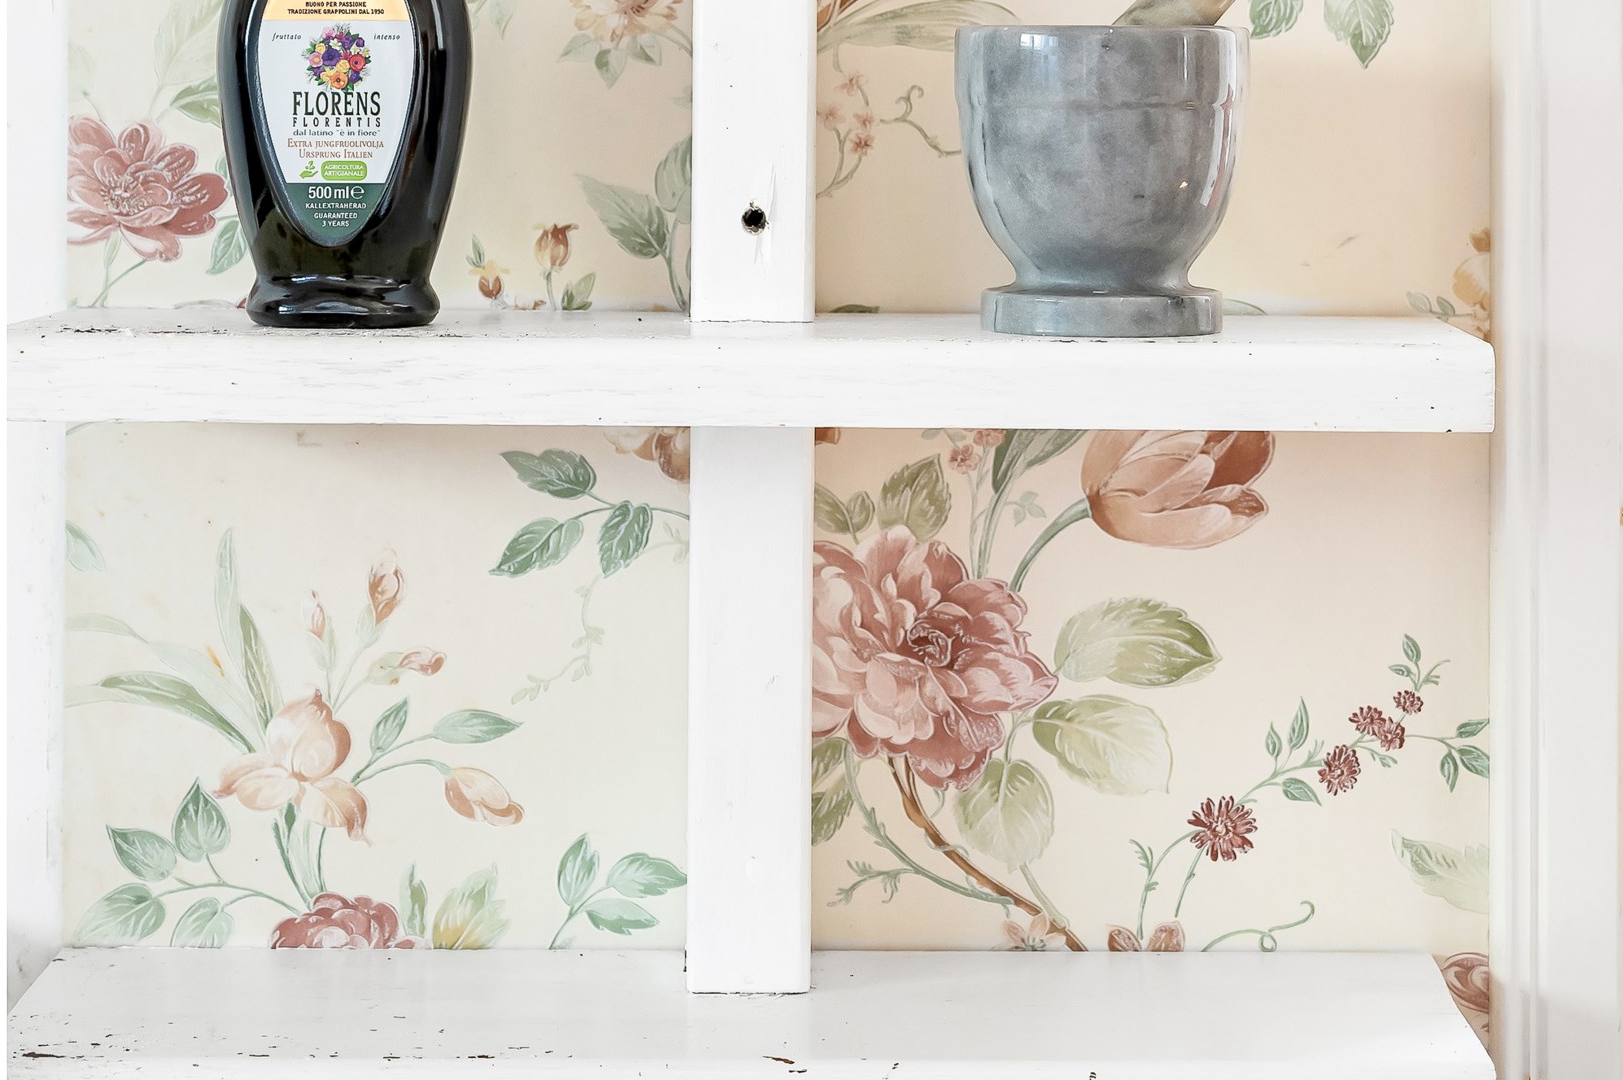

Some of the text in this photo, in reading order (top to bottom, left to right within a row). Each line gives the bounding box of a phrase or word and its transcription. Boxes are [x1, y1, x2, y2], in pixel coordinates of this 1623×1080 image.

[271, 32, 302, 41] fruttato
[373, 32, 401, 40] intenso
[292, 91, 381, 116] FLORENS
[292, 117, 381, 128] FLORENTIS
[292, 129, 307, 137] dal
[308, 129, 334, 137] latino
[347, 129, 355, 137] in
[308, 186, 332, 199] 500
